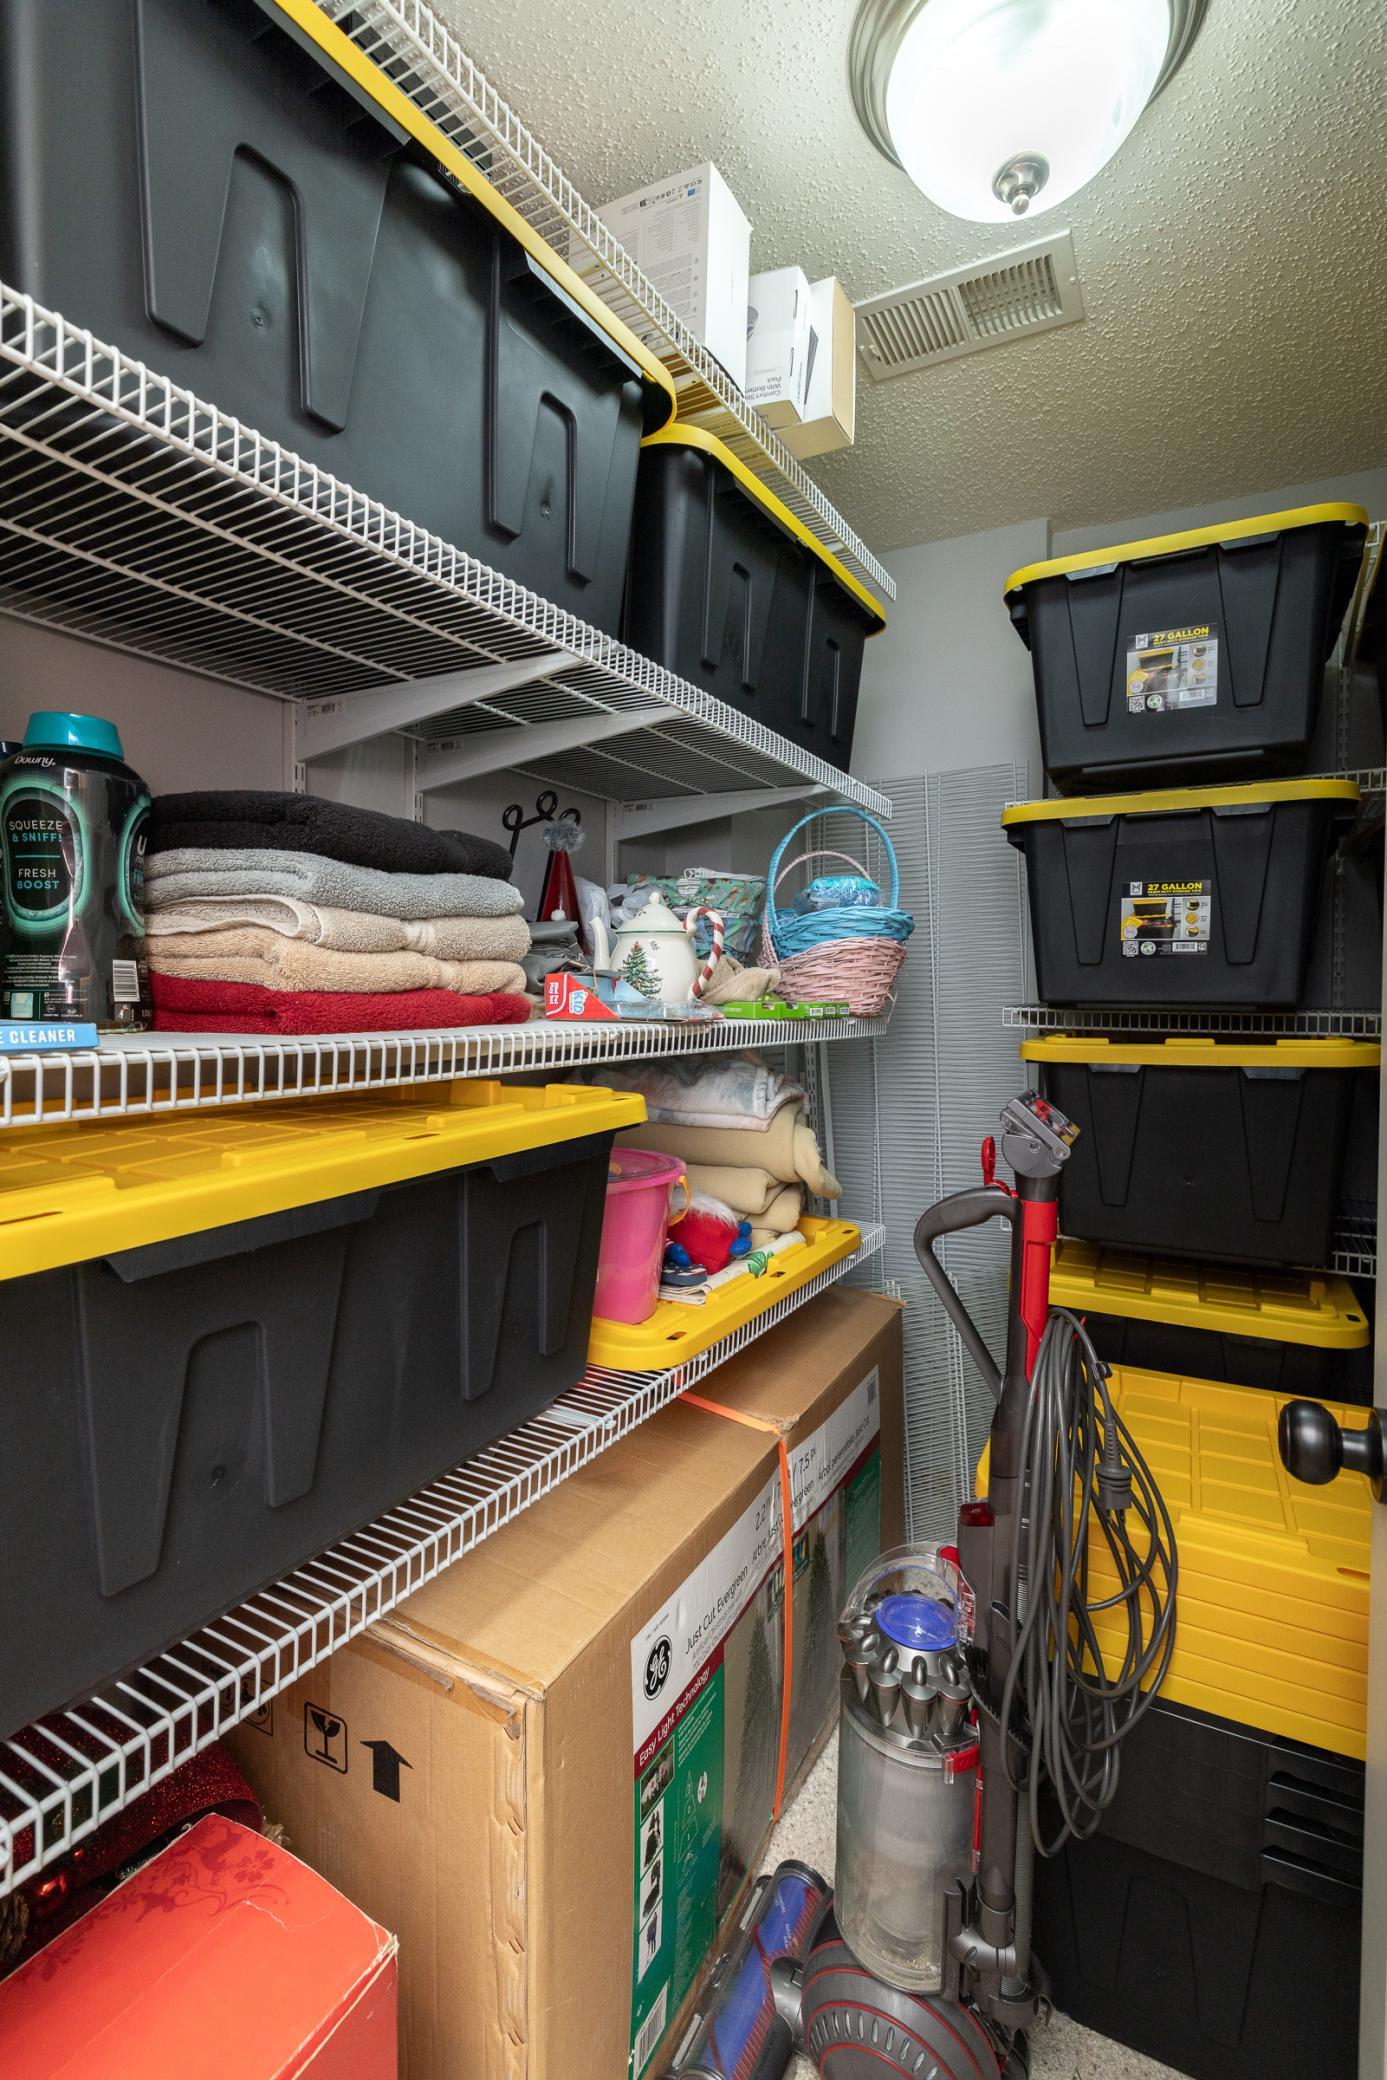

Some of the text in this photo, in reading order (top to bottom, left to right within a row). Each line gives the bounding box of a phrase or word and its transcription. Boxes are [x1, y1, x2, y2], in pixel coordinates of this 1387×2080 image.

[1153, 634, 1165, 642] 27
[1167, 627, 1209, 640] GALLON
[14, 755, 56, 767] Downy
[9, 820, 63, 831] SQUEEZE
[12, 833, 62, 842] & SNIFF!
[18, 868, 57, 878] FRESH
[16, 880, 59, 889] BOOST
[1161, 882, 1203, 890] GALLON
[9, 1029, 76, 1044] CLEANER
[685, 1565, 748, 1655] Just Cut Evergreen
[639, 1737, 657, 1767] Easy
[657, 1713, 675, 1742] Light
[675, 1666, 710, 1717] Technology
